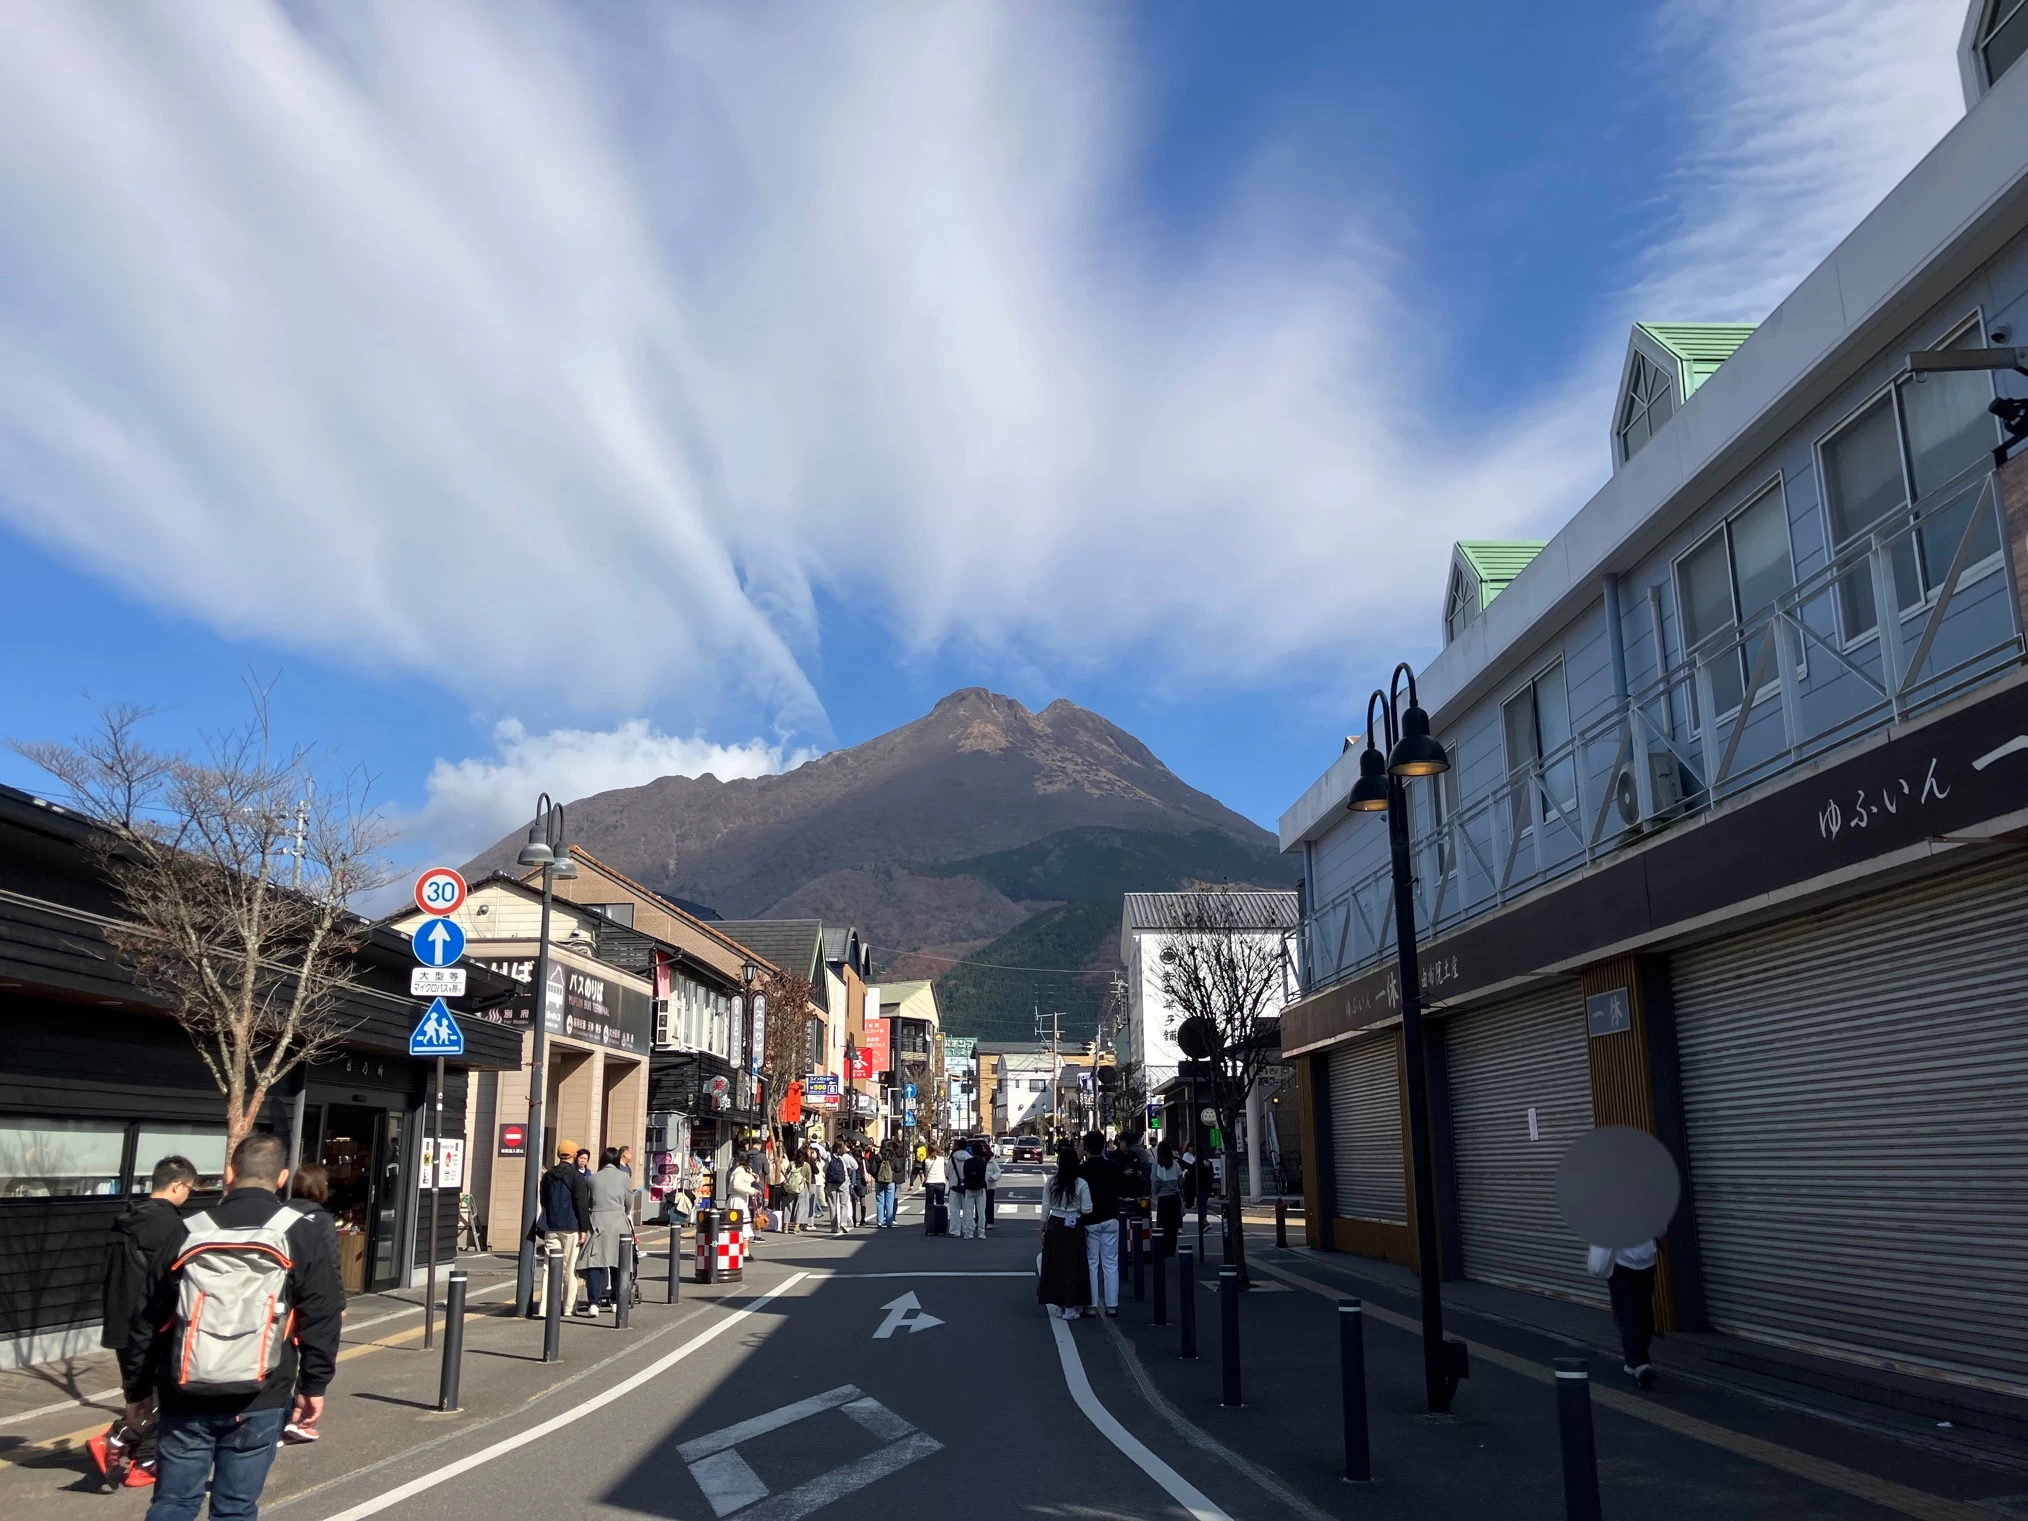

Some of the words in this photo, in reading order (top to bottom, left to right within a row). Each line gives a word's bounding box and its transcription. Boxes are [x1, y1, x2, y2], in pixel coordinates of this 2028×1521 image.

[1818, 757, 1951, 841] ゆふいん
[426, 881, 455, 902] 30
[414, 983, 462, 993] マイクロバスを除く
[419, 971, 459, 981] 大型等
[568, 973, 605, 1002] バスのりば
[1375, 971, 1400, 1009] 一休
[583, 1000, 592, 1011] BUS
[592, 1002, 610, 1017] TERMINAL
[1592, 995, 1624, 1027] 一休
[754, 999, 765, 1052] バスのりば
